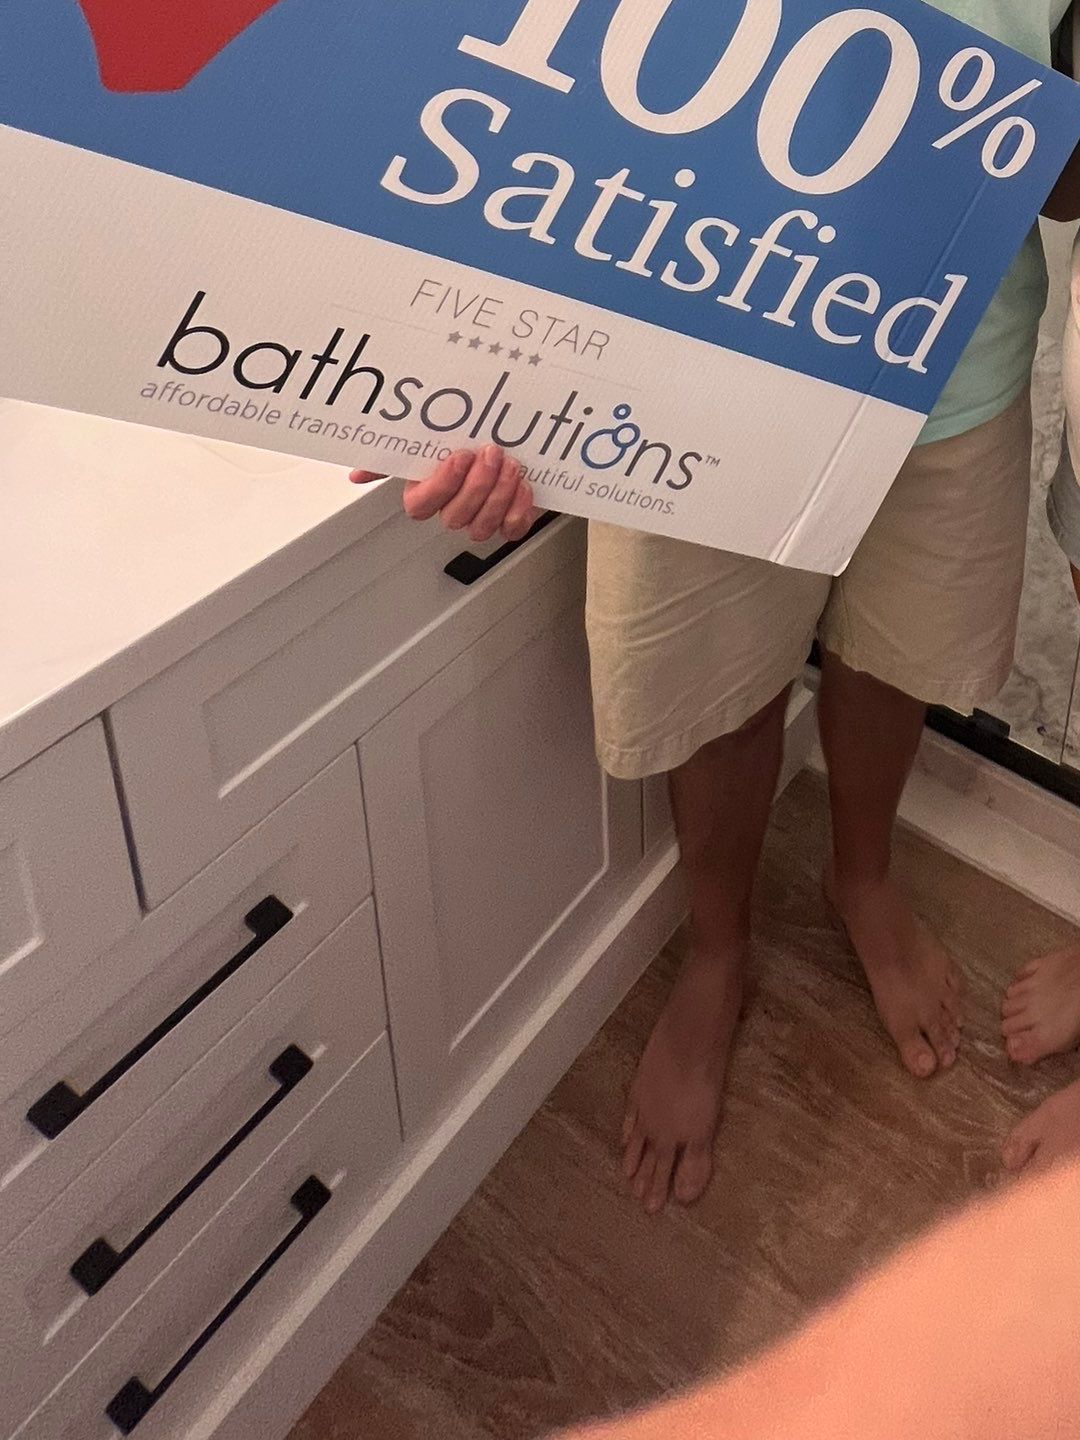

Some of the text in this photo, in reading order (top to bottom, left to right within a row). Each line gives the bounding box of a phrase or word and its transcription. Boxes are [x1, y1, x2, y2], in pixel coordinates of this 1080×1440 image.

[380, 88, 968, 374] Satisfied
[410, 278, 611, 360] FIVE STAR
[140, 380, 676, 516] affordable transformatio autiful solutions.
